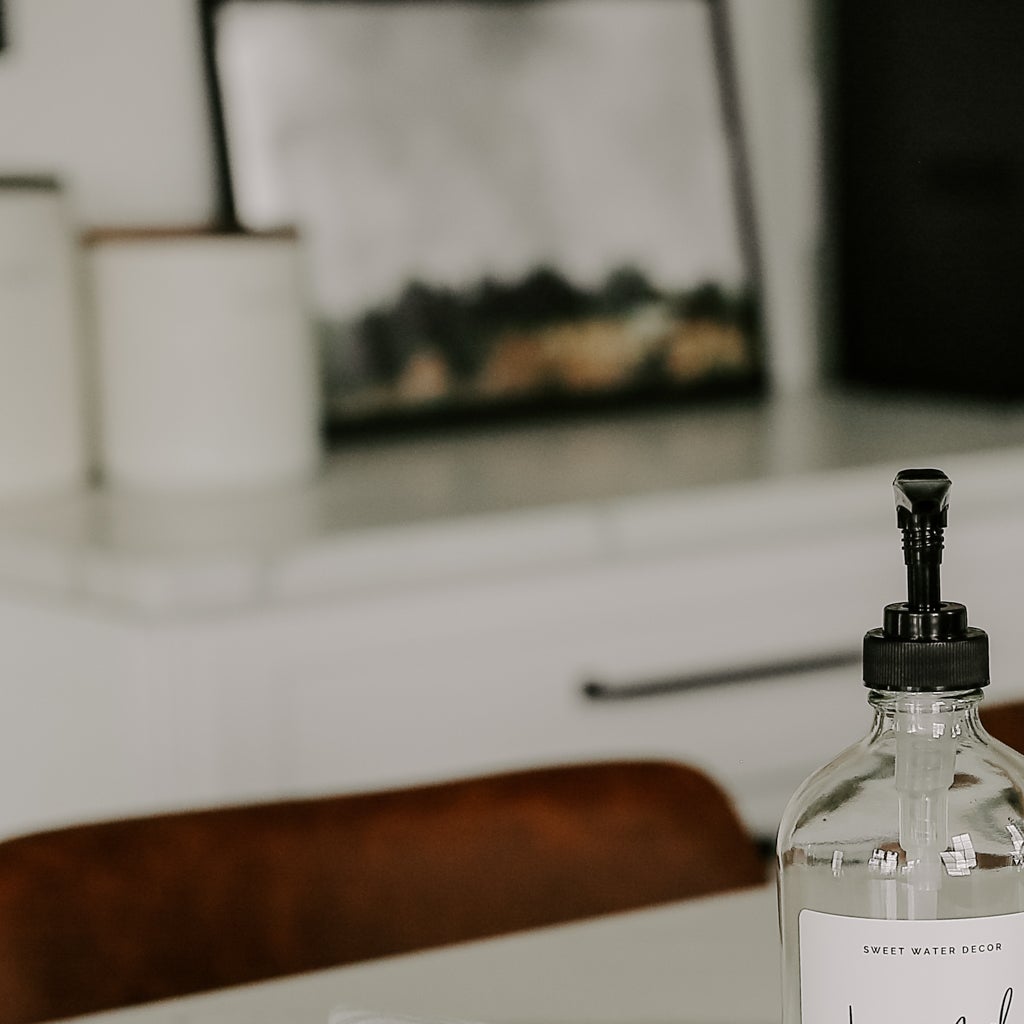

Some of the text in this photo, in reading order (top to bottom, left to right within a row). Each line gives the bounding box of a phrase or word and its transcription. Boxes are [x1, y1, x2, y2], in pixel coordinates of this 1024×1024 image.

[863, 942, 1002, 956] SWEET WATER DECOR
